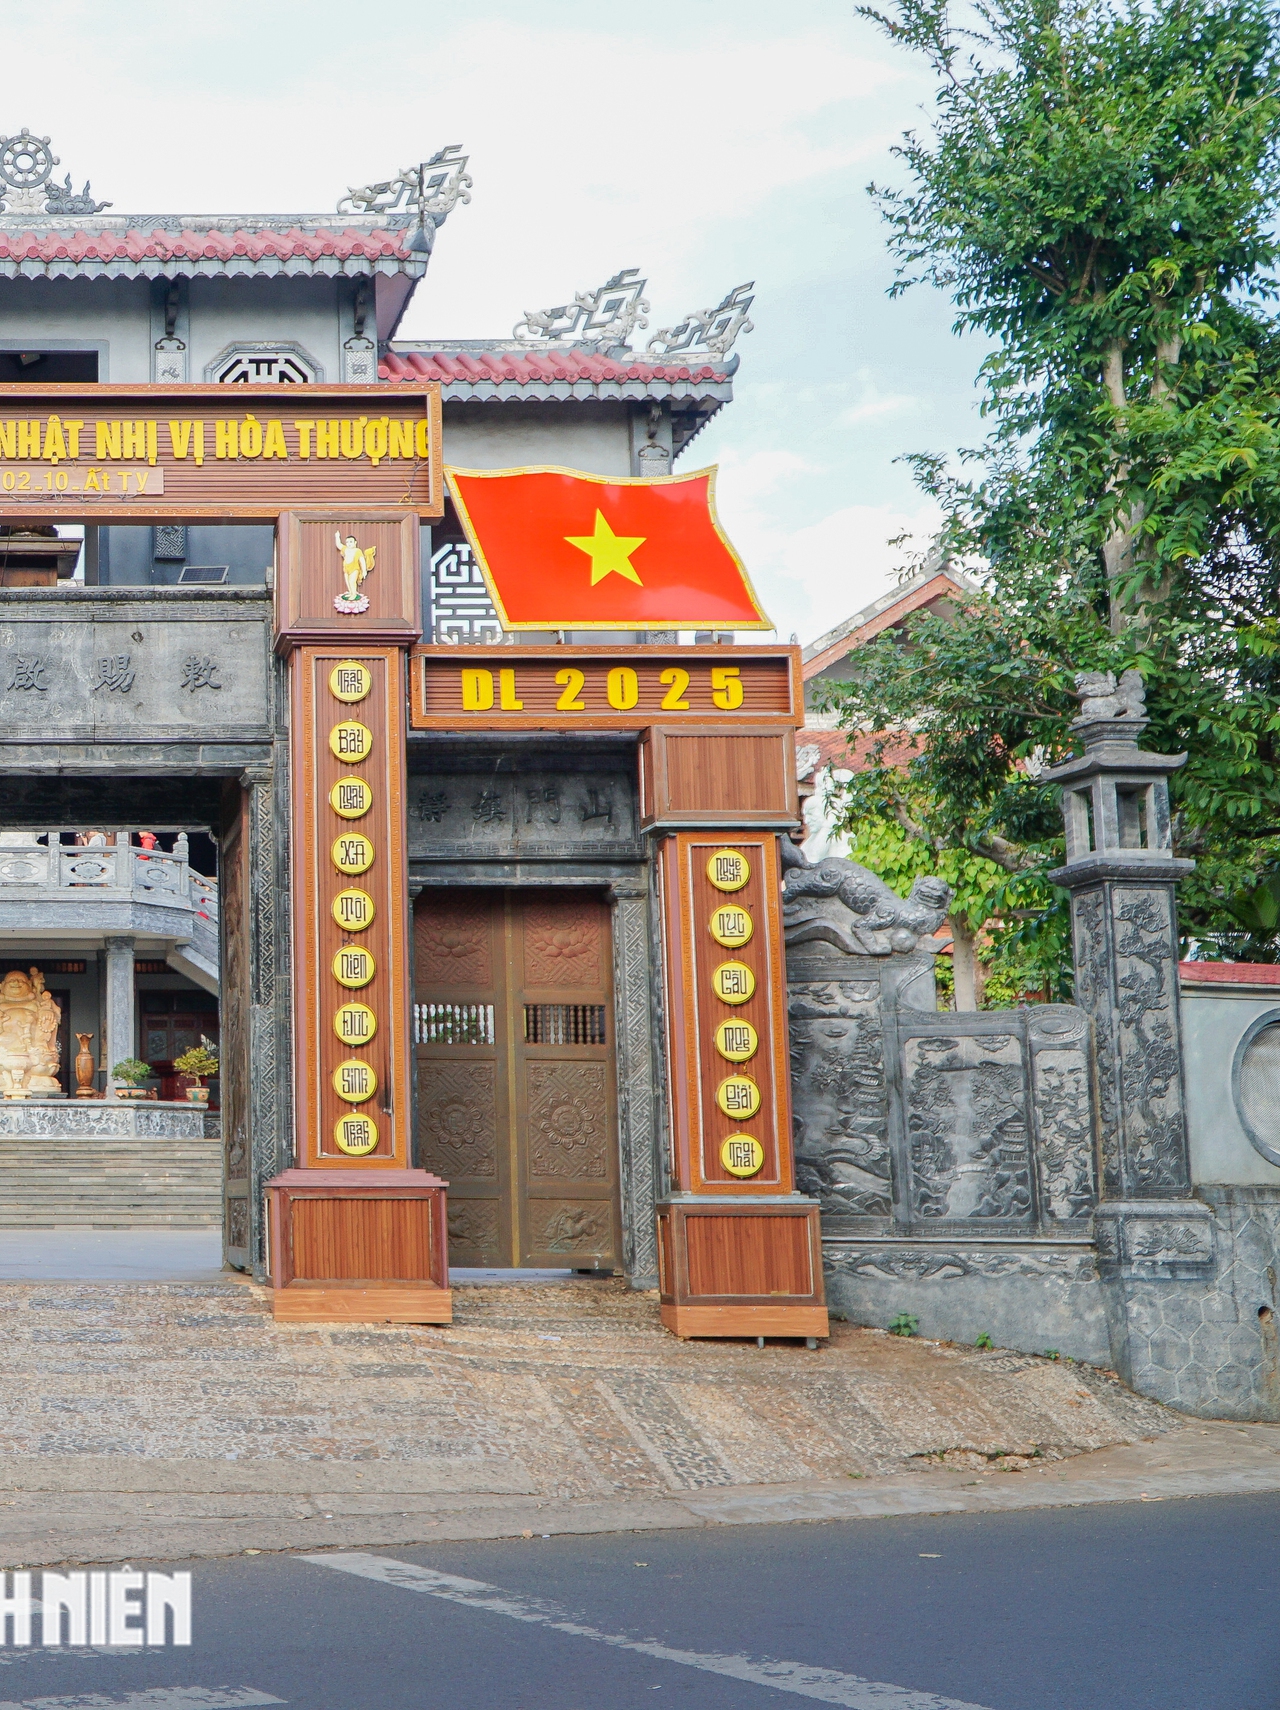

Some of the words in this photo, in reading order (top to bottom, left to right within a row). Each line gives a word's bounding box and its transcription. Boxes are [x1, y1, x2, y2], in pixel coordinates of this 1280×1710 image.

[95, 419, 157, 466] NHỊ
[168, 419, 205, 467] VỊ
[215, 413, 288, 460] HÒA
[294, 415, 429, 467] THƯỢNG
[461, 668, 524, 711] DL
[554, 667, 745, 711] 2025
